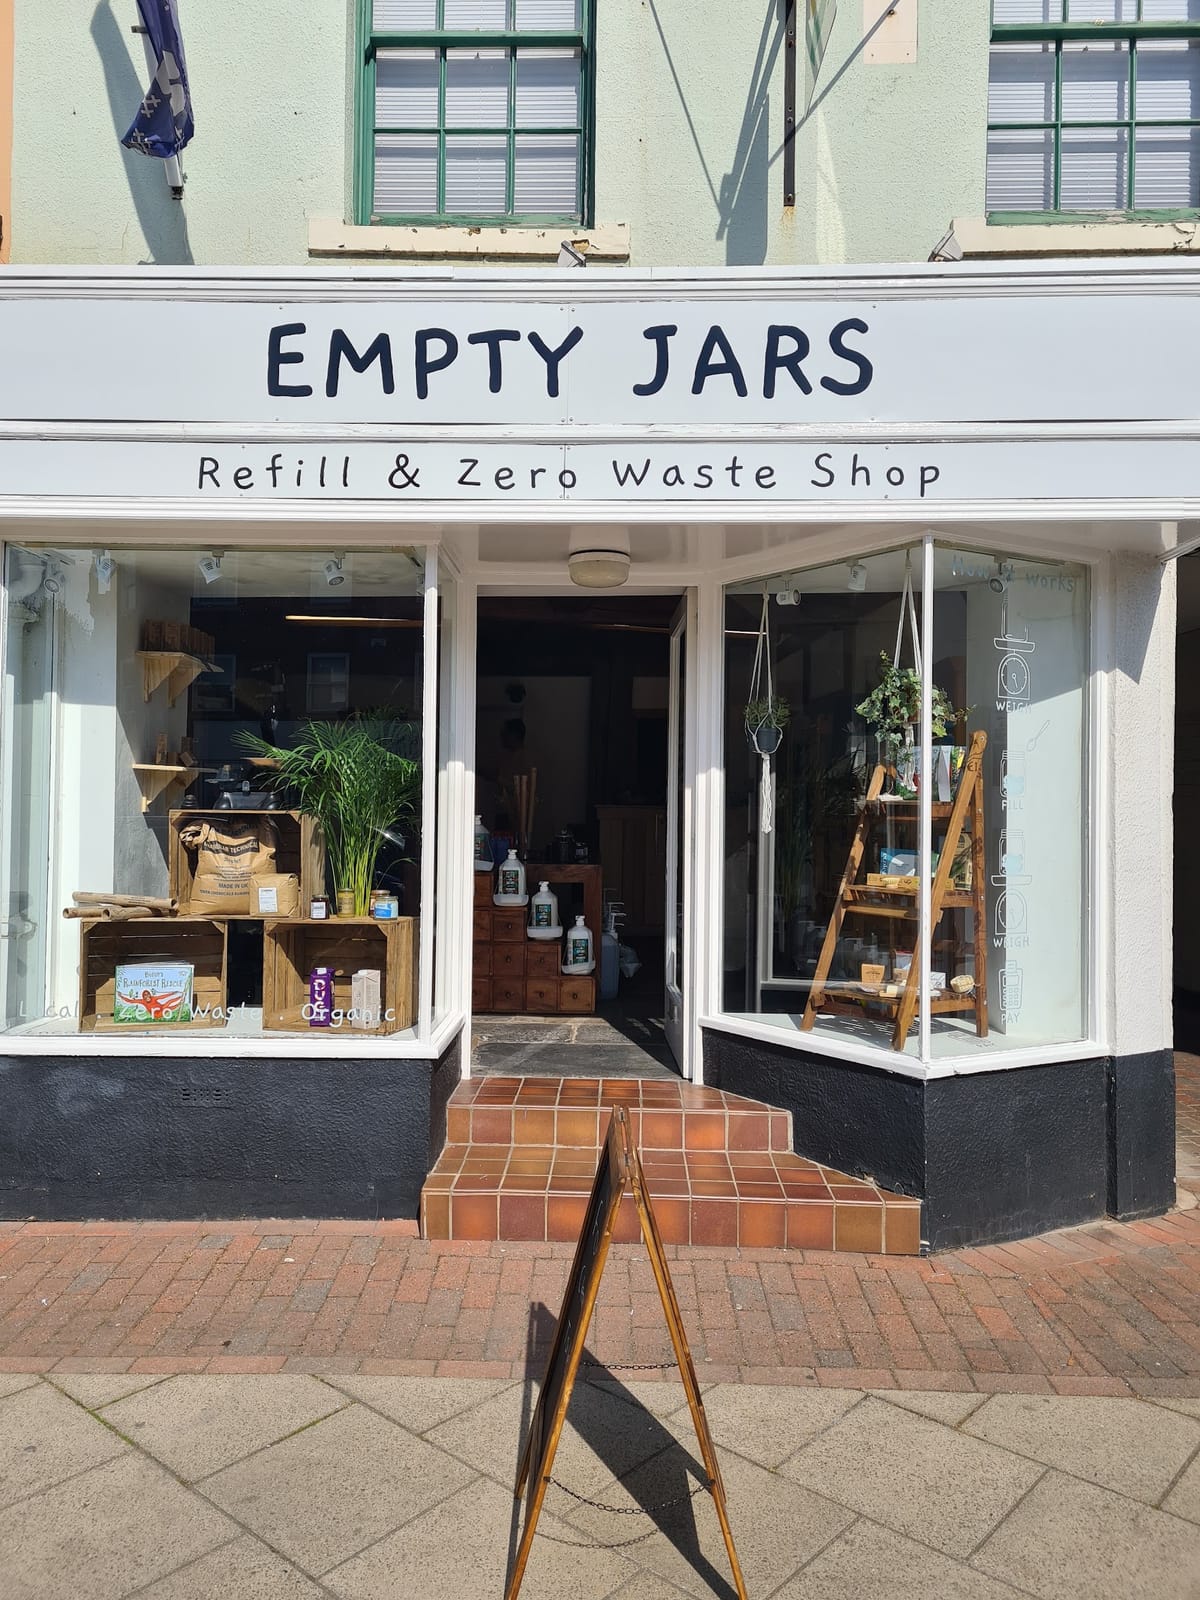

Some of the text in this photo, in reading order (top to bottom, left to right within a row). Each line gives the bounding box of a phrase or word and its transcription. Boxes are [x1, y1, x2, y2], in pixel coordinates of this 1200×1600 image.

[267, 318, 874, 399] EMPTY JARS
[199, 453, 940, 498] Refill & Zero Waste Shop
[996, 700, 1032, 713] WEIGH
[1002, 799, 1024, 812] FILL
[993, 937, 1030, 949] WEIGH
[118, 1003, 173, 1020] Zero
[190, 1002, 260, 1021] Waste
[301, 999, 396, 1028] Organic
[1002, 1013, 1019, 1024] PAY
